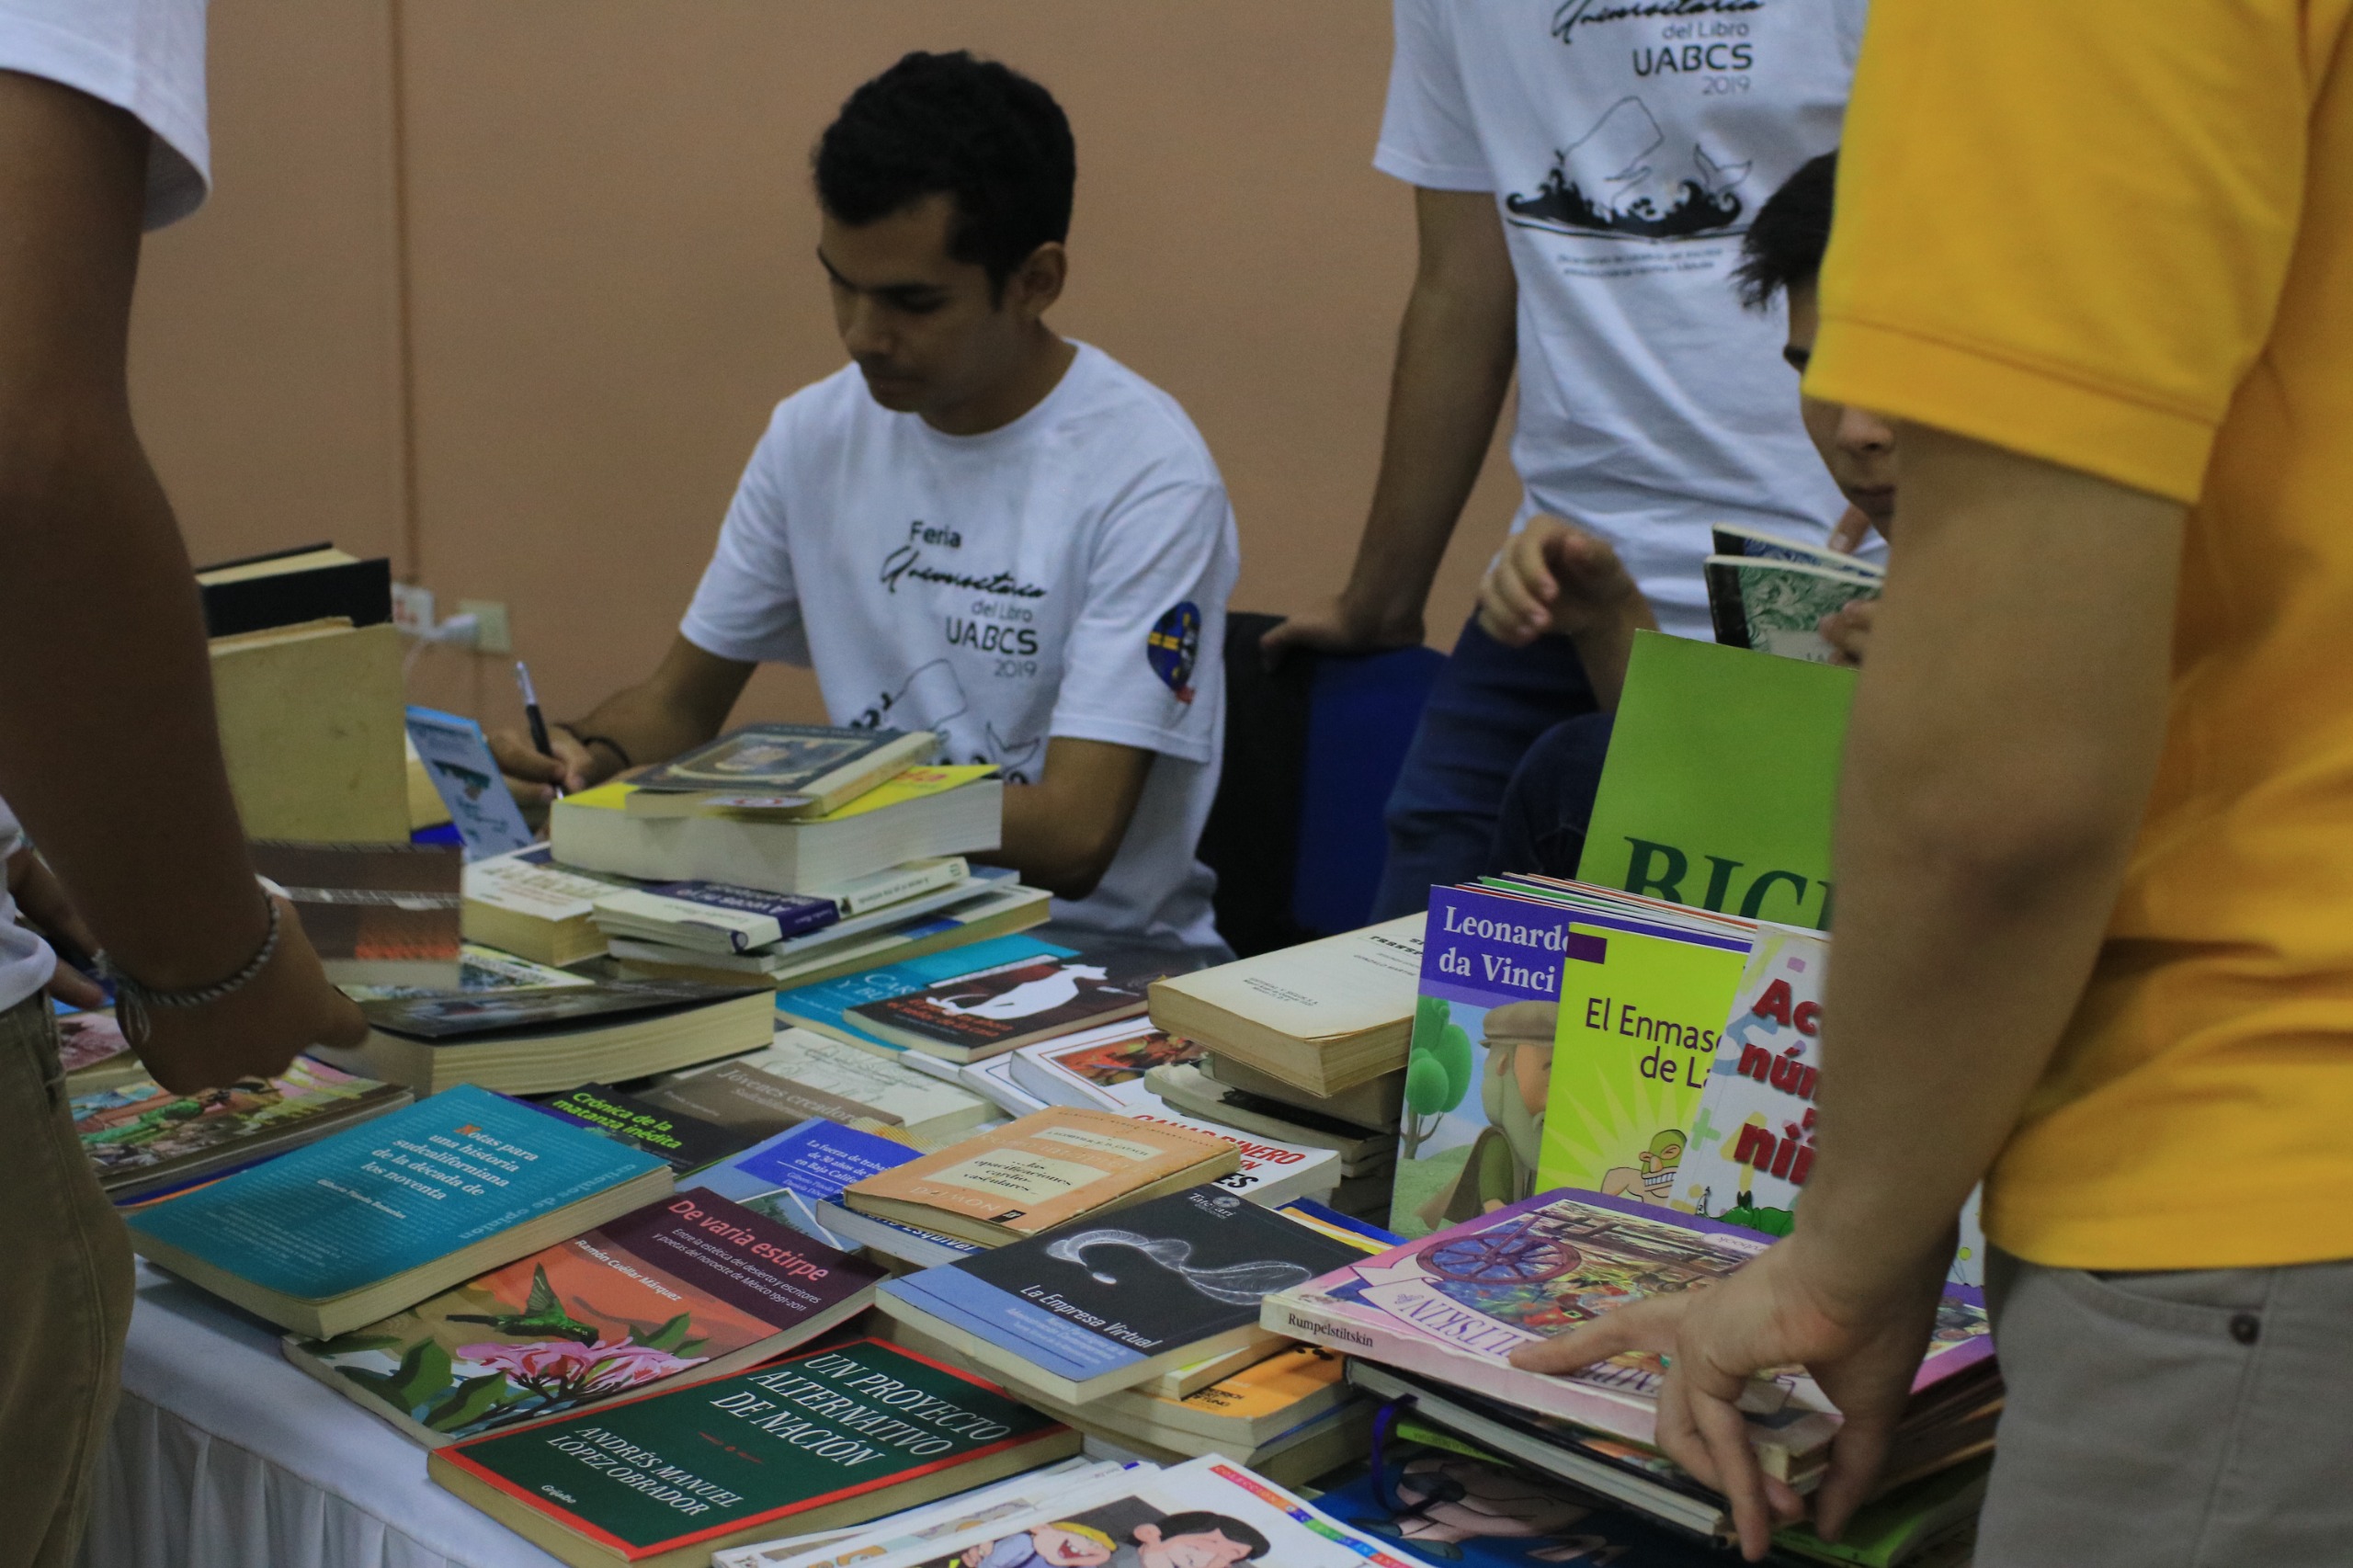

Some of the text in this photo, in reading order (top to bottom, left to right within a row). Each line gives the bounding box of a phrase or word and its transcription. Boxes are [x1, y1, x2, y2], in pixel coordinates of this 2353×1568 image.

[1662, 19, 1750, 40] del Libro
[1632, 43, 1754, 76] UABCS
[1702, 75, 1751, 96] 2019
[910, 520, 962, 549] Feria
[972, 599, 1033, 623] del Libro
[946, 616, 1040, 655] UABCS
[994, 658, 1037, 678] 2019
[1439, 947, 1472, 977] da
[1481, 953, 1556, 993] Vinci
[1586, 997, 1610, 1031] El
[1640, 1046, 1677, 1083] de
[573, 1092, 674, 1131] Crónica de la
[716, 1069, 789, 1098] Jóvenes
[786, 1094, 857, 1121] creador
[552, 1100, 683, 1149] matanza inédita
[392, 1138, 510, 1187] sudcaliforniana
[428, 1134, 520, 1172] una historia
[496, 1141, 539, 1162] para
[794, 1158, 808, 1166] en
[807, 1162, 830, 1175] Baja
[806, 1140, 820, 1148] La
[819, 1143, 849, 1158] fuerza
[847, 1154, 861, 1163] de
[807, 1152, 821, 1160] de
[853, 1167, 867, 1176] de
[360, 1162, 447, 1200] los noventa
[371, 1148, 485, 1196] de la década de
[531, 1197, 556, 1210] de
[667, 1199, 829, 1282] De varia estirpe
[574, 1239, 684, 1301] Ramón Cuéllar Márquez
[658, 1235, 688, 1255] poetas
[686, 1246, 700, 1260] del
[699, 1254, 735, 1277] noroeste
[731, 1270, 744, 1281] de
[741, 1275, 772, 1297] México
[672, 1228, 697, 1243] Entre
[694, 1235, 703, 1246] la
[700, 1241, 733, 1263] estética
[731, 1256, 745, 1267] del
[743, 1260, 779, 1284] desierto
[780, 1278, 822, 1304] escritores
[1020, 1284, 1040, 1298] La
[1039, 1293, 1106, 1327] Empresa
[1103, 1322, 1164, 1349] Virtual
[1288, 1312, 1374, 1348] Rumpelstiltskin
[746, 1369, 953, 1456] ALTERNATIVO
[804, 1353, 1012, 1441] UN PROYECTO
[709, 1390, 887, 1468] DE NACIÓN
[546, 1433, 710, 1517] LÓPEZ OBRADOR
[574, 1426, 745, 1508] ANDRÉS MANUEL
[540, 1483, 577, 1505] Grijalbo
